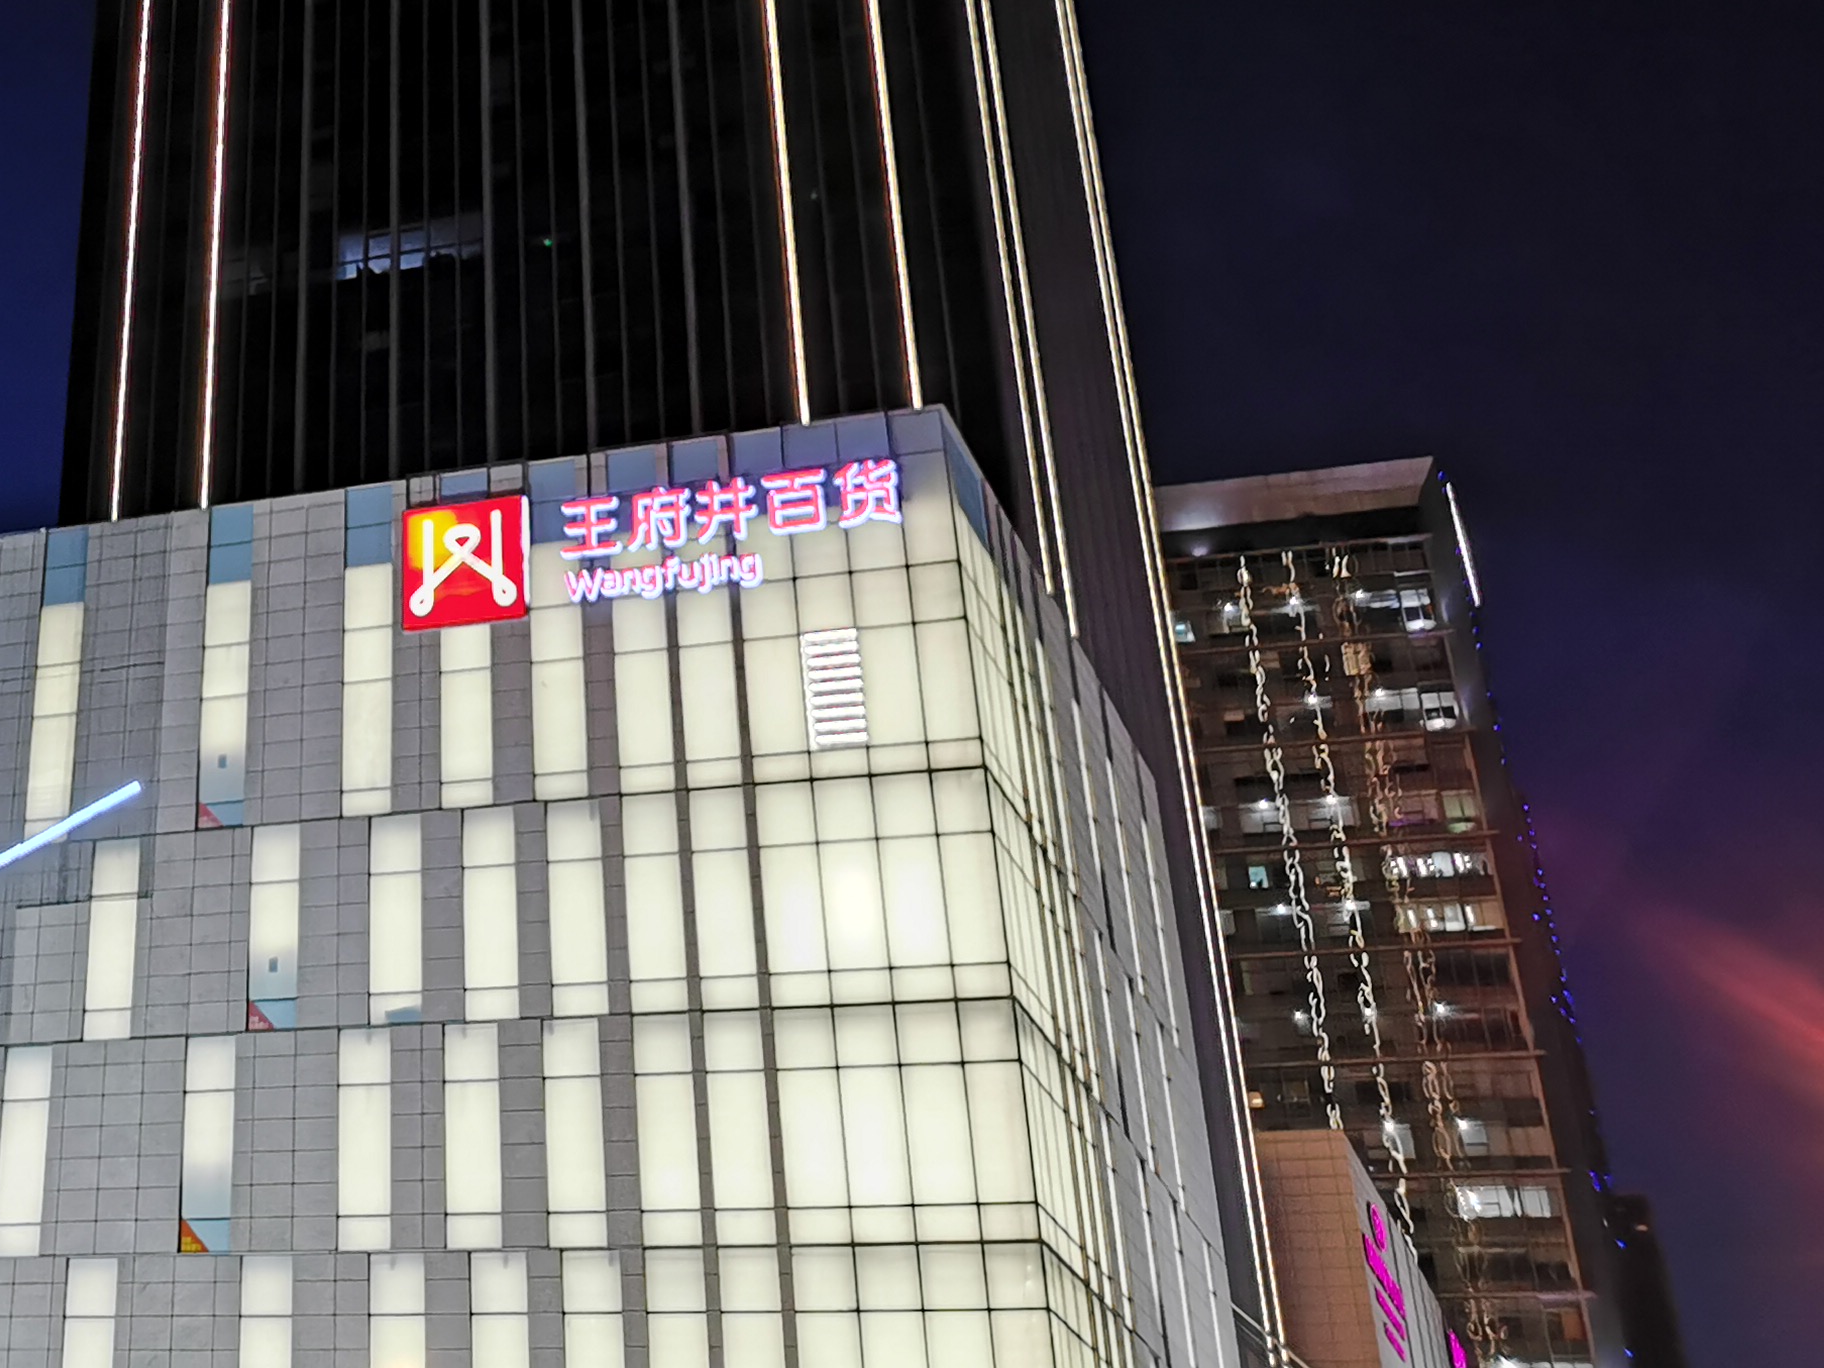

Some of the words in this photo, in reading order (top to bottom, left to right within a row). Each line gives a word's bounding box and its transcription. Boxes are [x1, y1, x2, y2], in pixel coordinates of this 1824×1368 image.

[560, 458, 903, 561] 王府井百货
[563, 551, 764, 604] Wangfujing
